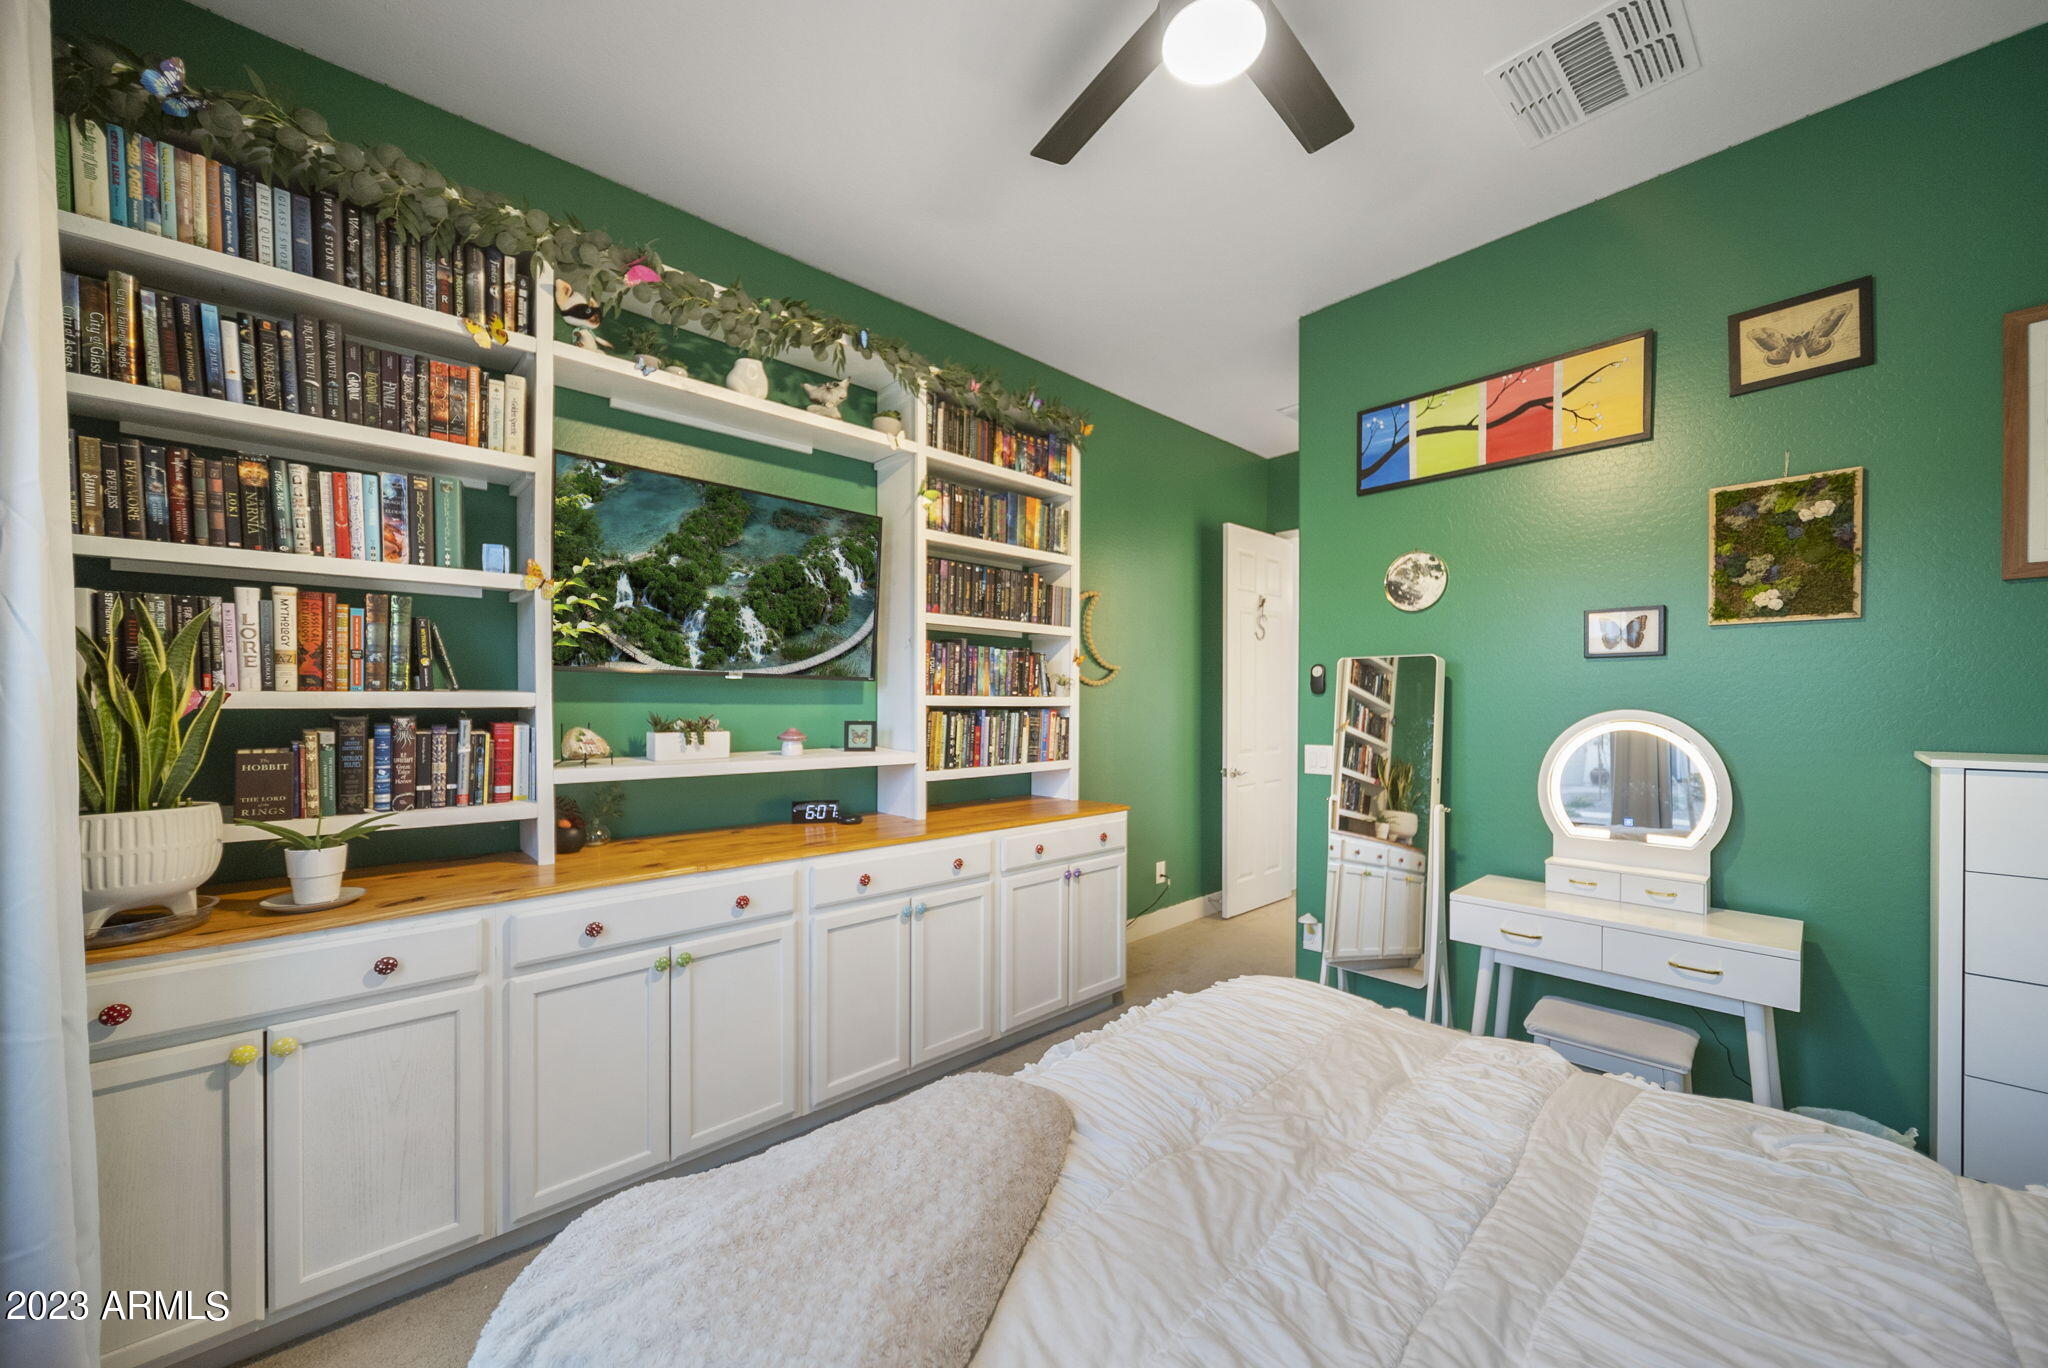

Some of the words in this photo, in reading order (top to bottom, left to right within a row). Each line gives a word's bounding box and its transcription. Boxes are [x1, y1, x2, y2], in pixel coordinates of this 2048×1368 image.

[260, 194, 269, 215] RED
[278, 196, 288, 226] GLASS
[324, 198, 332, 220] WAR
[260, 226, 270, 266] QUEEN
[325, 234, 334, 271] STORM
[114, 288, 128, 305] City
[63, 306, 76, 326] City
[86, 312, 104, 334] City
[182, 303, 190, 326] DESSEN
[65, 328, 76, 336] of
[90, 336, 103, 345] of
[118, 316, 128, 340] Fallen
[302, 326, 314, 351] BLACK
[324, 330, 336, 348] IRON
[65, 338, 77, 368] Ashes
[184, 332, 192, 350] SAINT
[91, 346, 104, 374] Glass
[116, 340, 130, 368] Angels
[186, 350, 196, 381] ANYTHING
[305, 352, 316, 378] WITCH
[326, 350, 336, 378] FLOWER
[262, 342, 276, 402] INCARCERON
[382, 380, 397, 410] FINALE
[104, 468, 119, 508] EVERLESS
[274, 470, 283, 491] LOSING
[228, 492, 238, 518] LOKI
[246, 491, 260, 534] NARNIA
[105, 592, 114, 618] STEPHEN
[156, 600, 165, 612] FEAR
[184, 606, 192, 618] FEAR
[280, 598, 290, 647] MYTHOLOGY
[311, 602, 320, 642] CLASSICAL
[240, 614, 257, 668] LORE
[242, 763, 290, 772] HOBBIT
[241, 807, 286, 817] RINGS
[805, 804, 837, 820] 6:07
